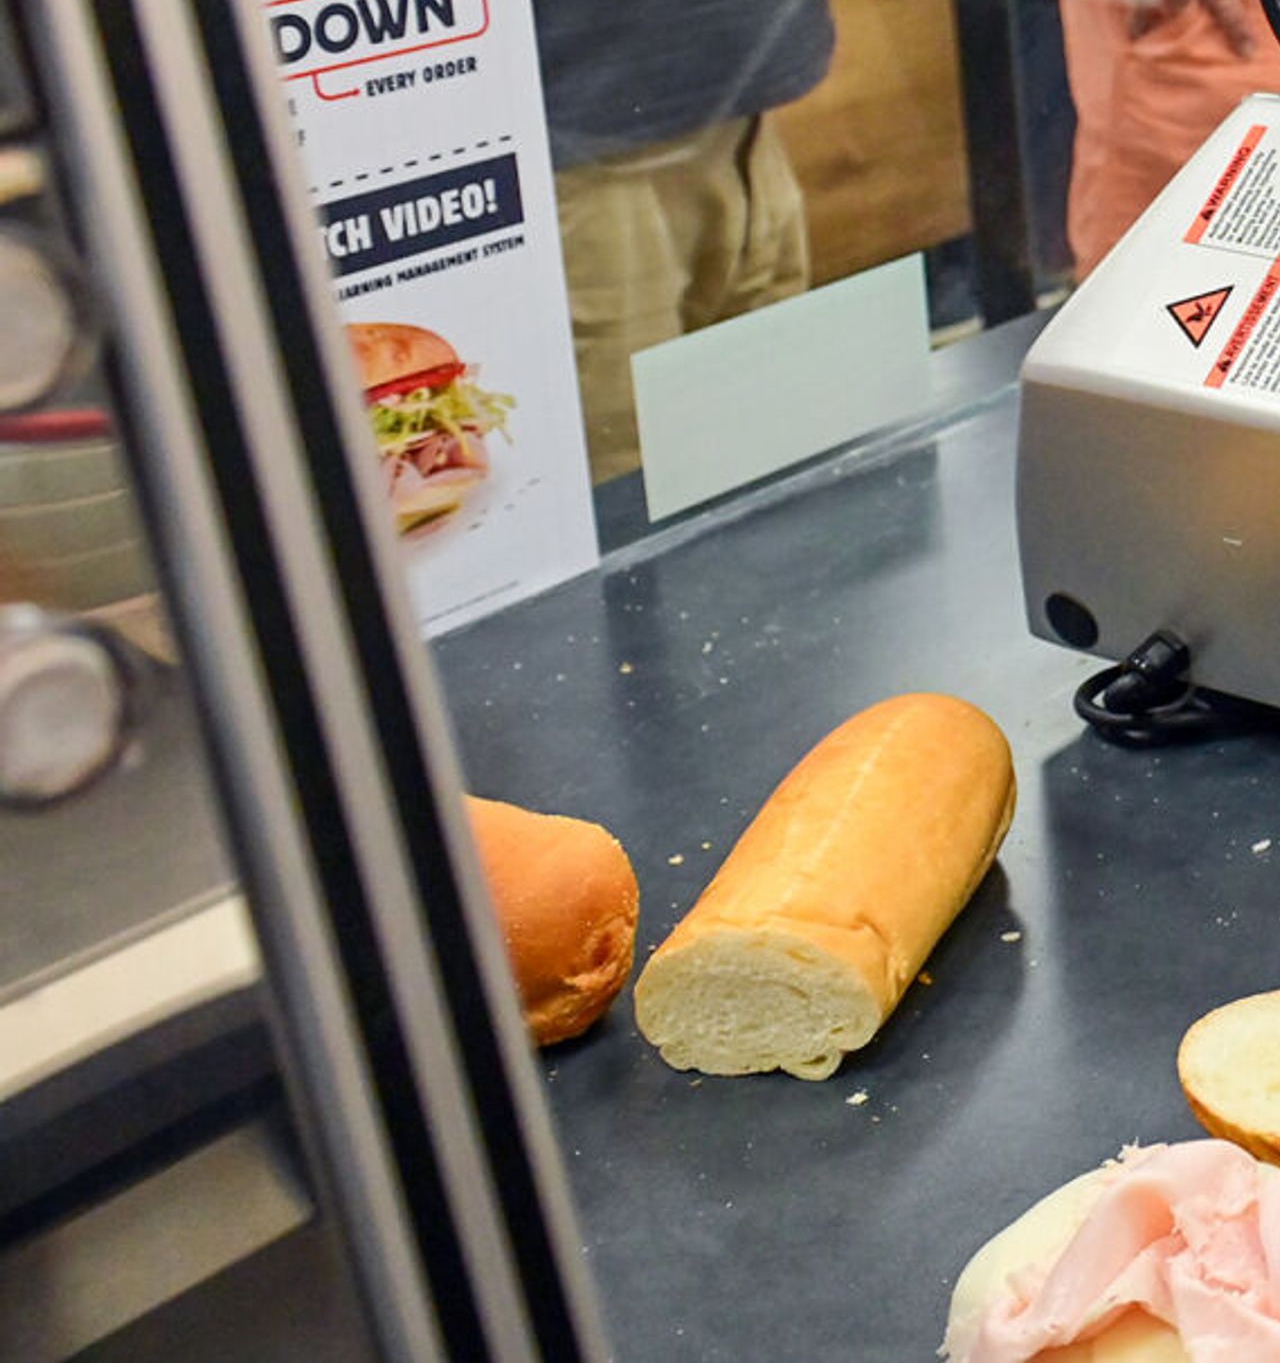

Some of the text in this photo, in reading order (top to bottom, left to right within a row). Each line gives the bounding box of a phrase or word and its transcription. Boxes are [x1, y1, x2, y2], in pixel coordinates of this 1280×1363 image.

[365, 56, 478, 98] EVERY ORDER
[1206, 145, 1253, 211] WARNING
[380, 179, 498, 243] VIDEO!
[396, 248, 480, 283] MANAGEMENT
[482, 235, 525, 259] SYSTEM
[1223, 274, 1279, 361] AVERTISSEMENT
